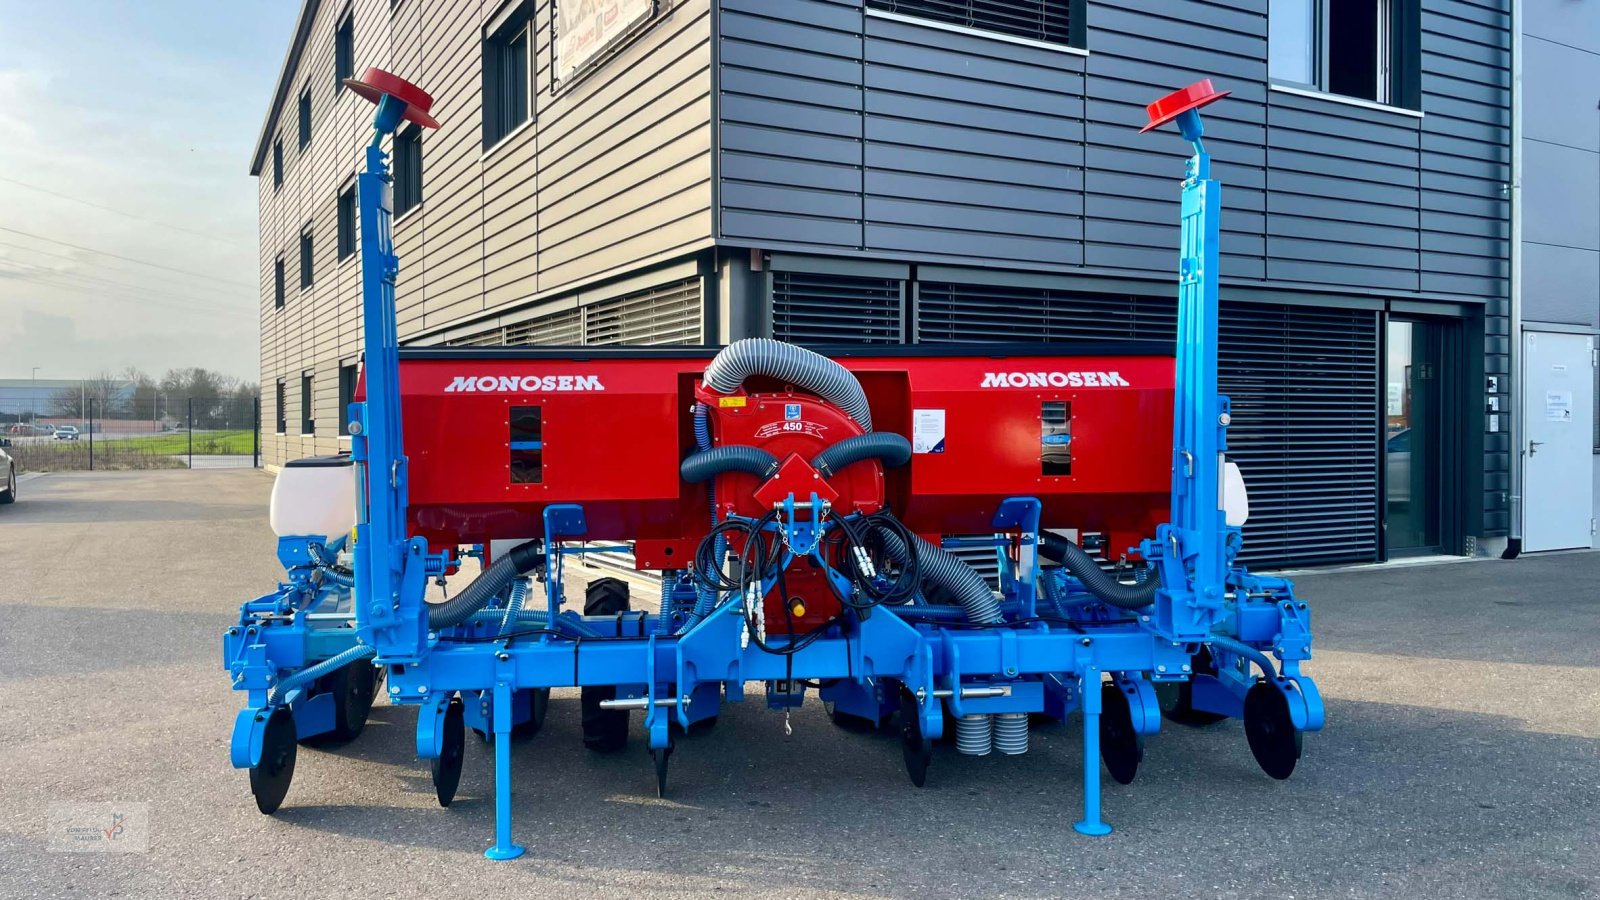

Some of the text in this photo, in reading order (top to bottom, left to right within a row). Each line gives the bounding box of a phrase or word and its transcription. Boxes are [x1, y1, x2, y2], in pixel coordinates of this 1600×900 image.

[444, 375, 605, 392] MONOSEM
[980, 371, 1130, 388] MONOSEM
[783, 422, 802, 431] 450
